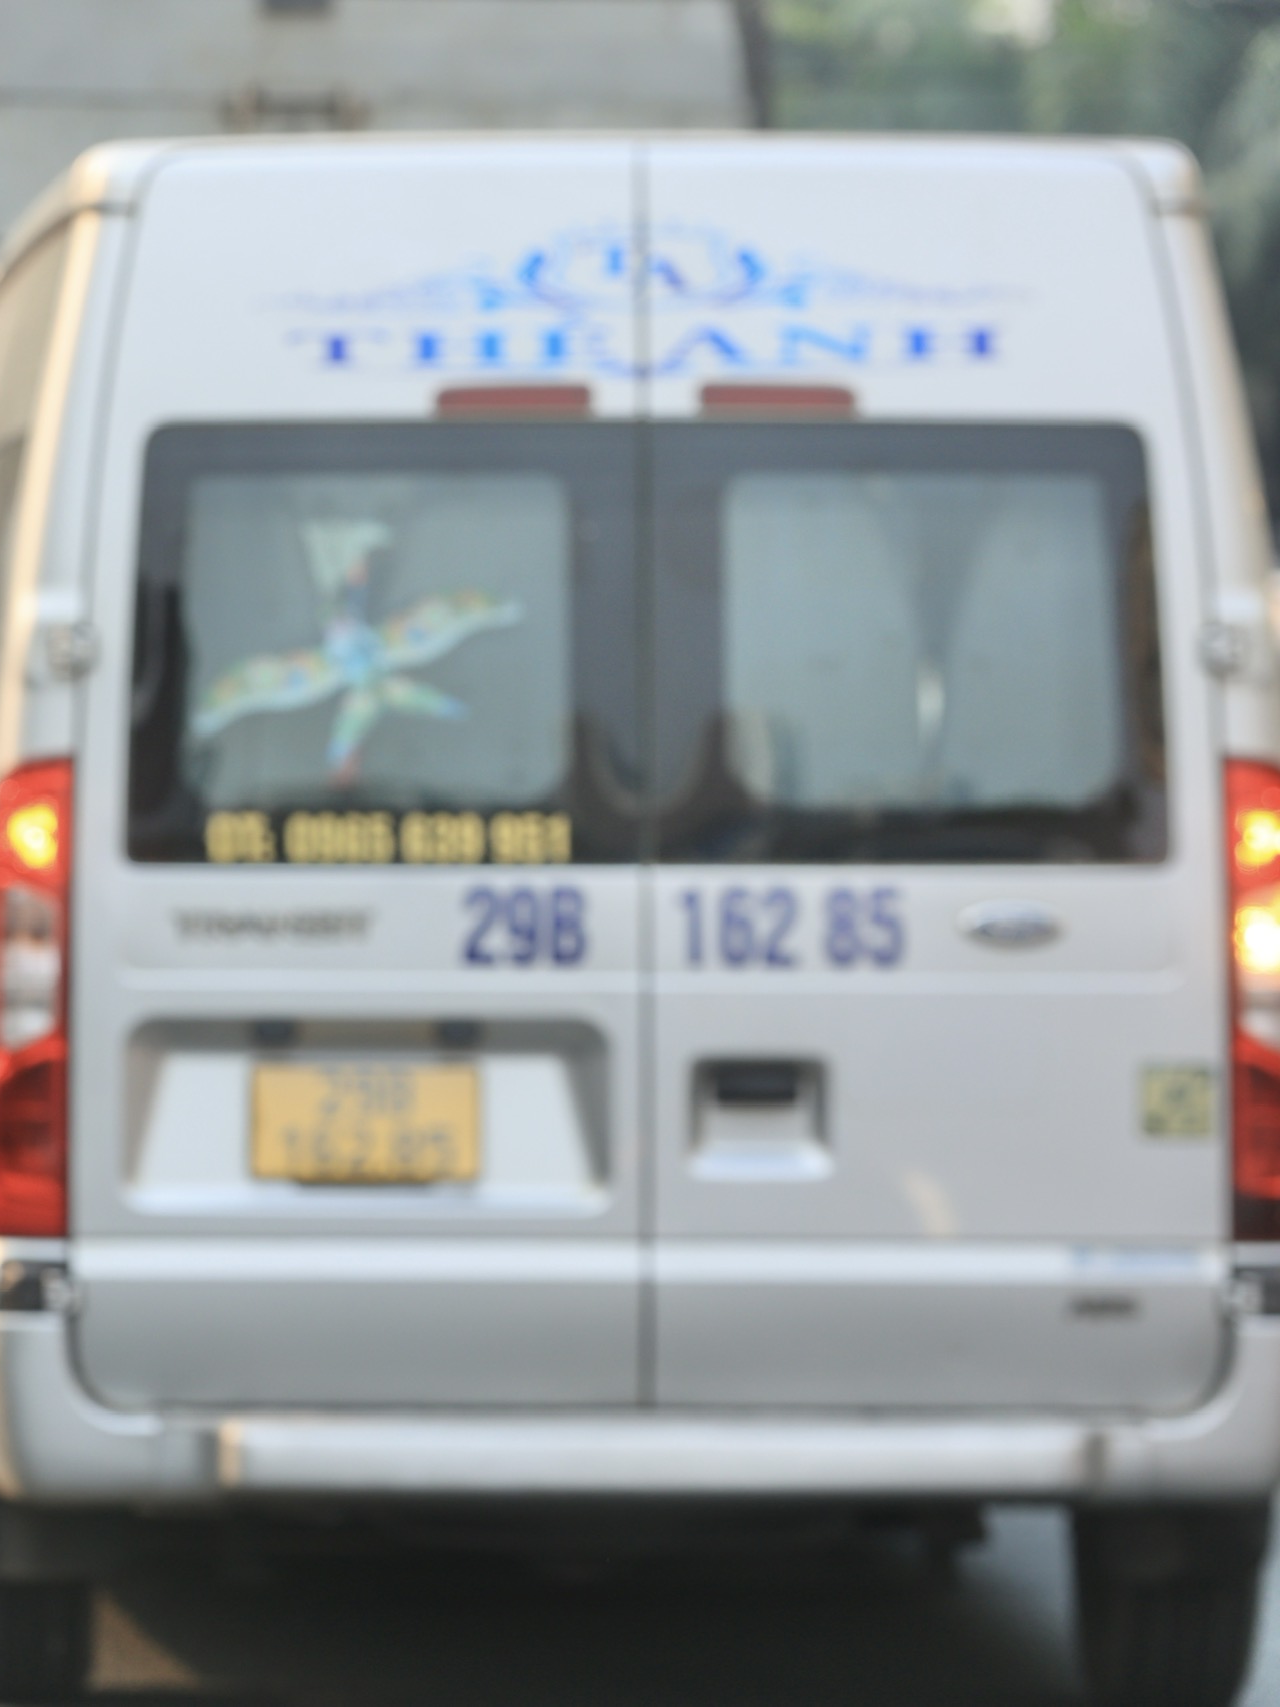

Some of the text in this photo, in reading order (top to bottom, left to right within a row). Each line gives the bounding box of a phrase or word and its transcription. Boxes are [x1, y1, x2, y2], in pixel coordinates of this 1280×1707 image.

[461, 885, 587, 967] 29B
[678, 885, 800, 968] 162
[820, 885, 907, 968] 85
